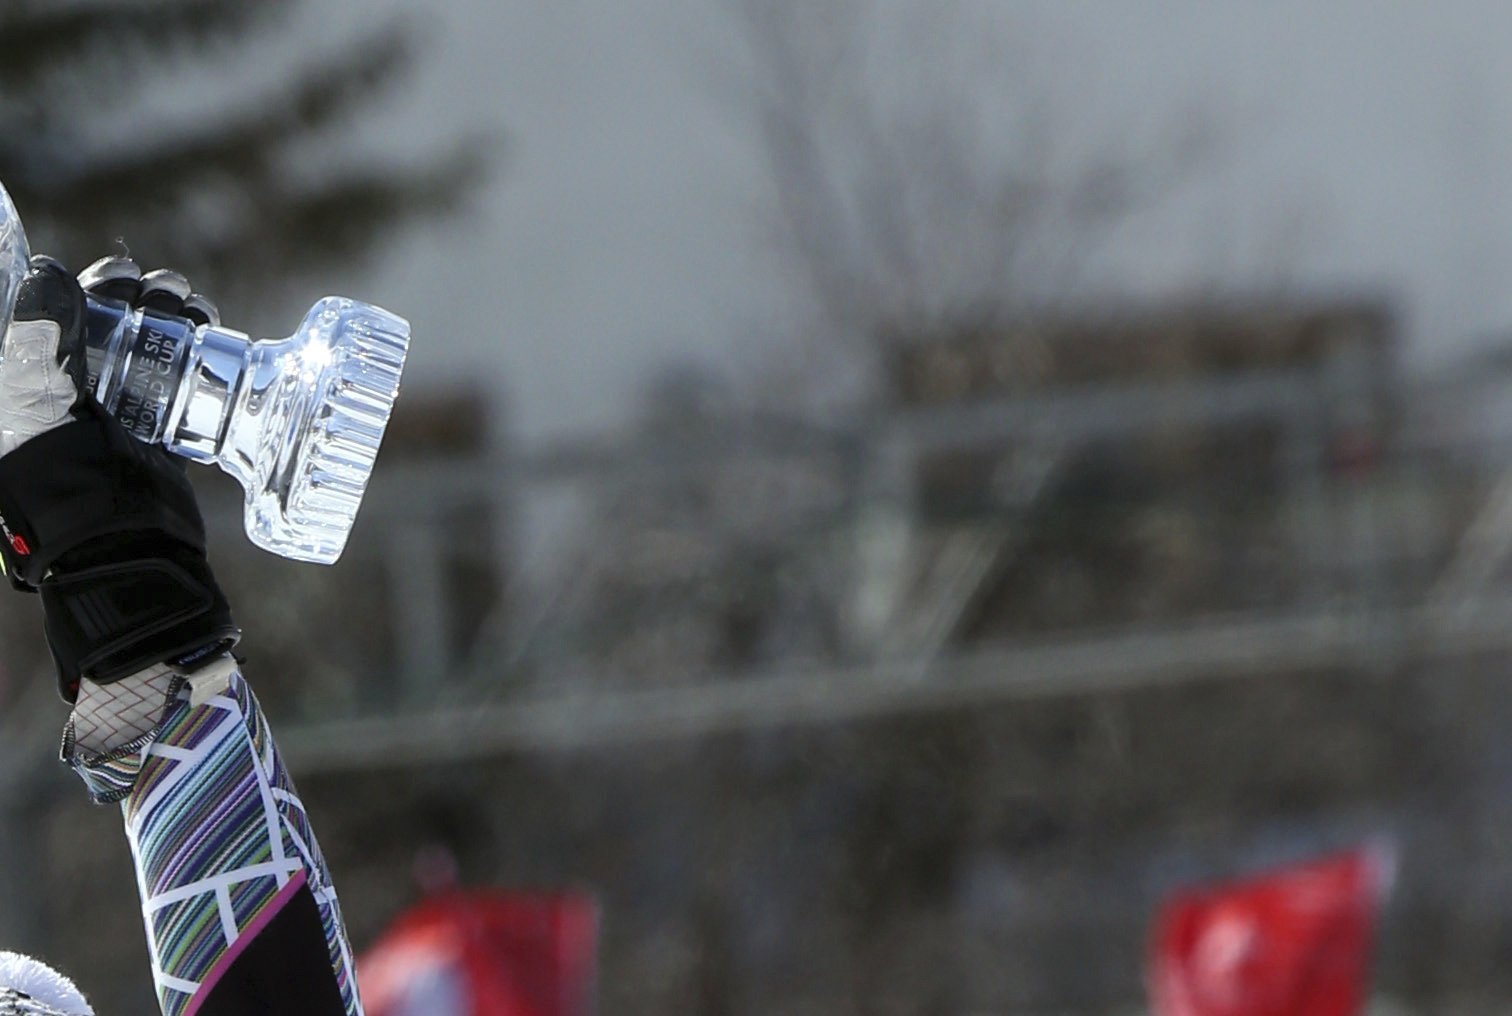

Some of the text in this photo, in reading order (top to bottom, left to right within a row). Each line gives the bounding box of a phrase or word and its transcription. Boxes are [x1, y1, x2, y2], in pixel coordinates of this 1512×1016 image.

[123, 357, 155, 416] ALPINE
[144, 328, 164, 354] SKI
[134, 340, 177, 435] WORLD CUP
